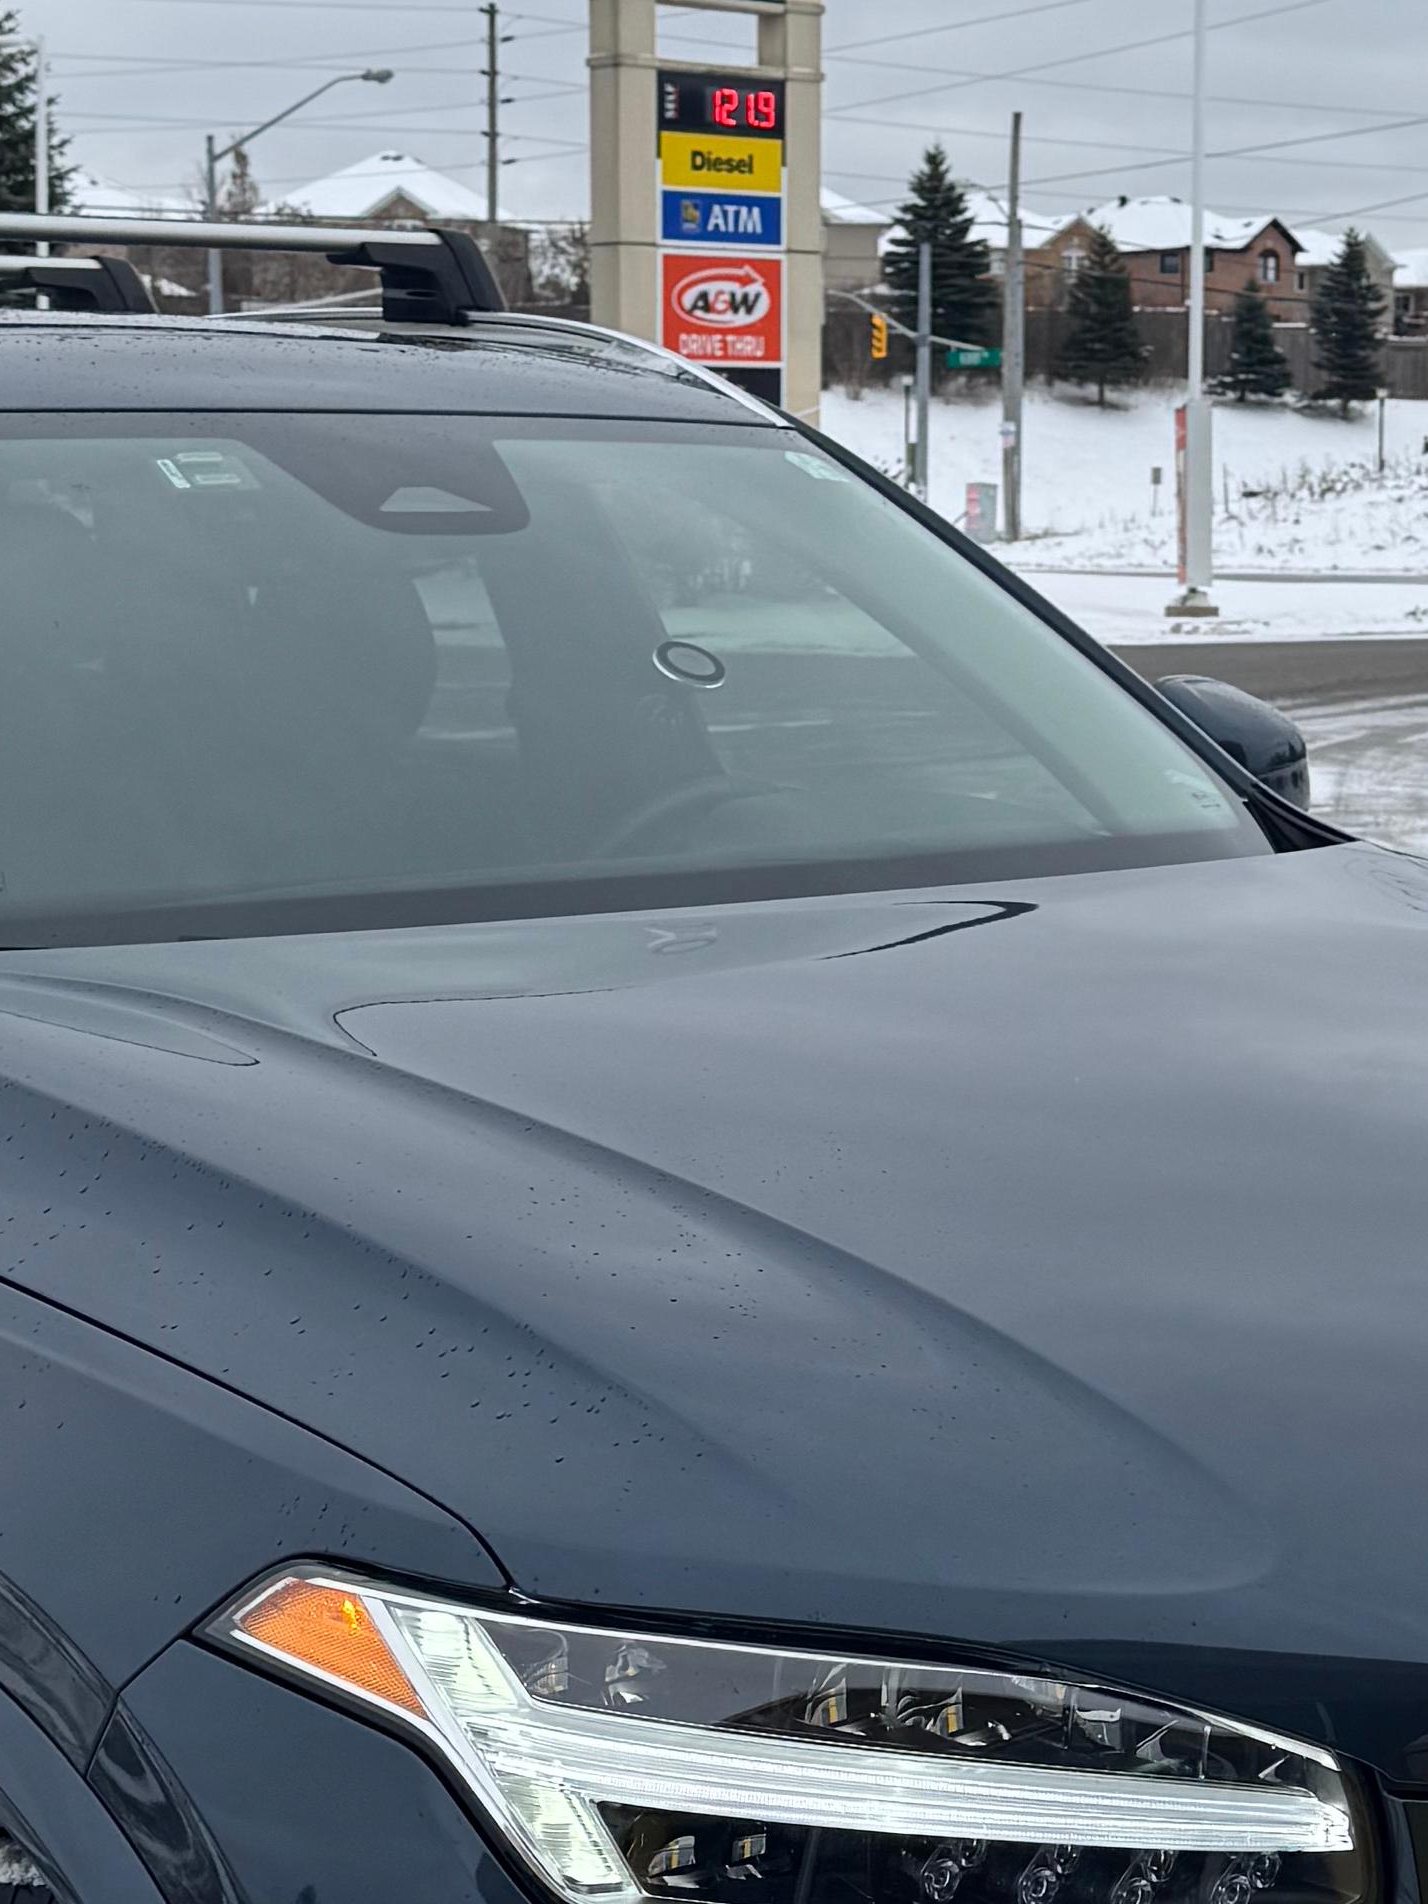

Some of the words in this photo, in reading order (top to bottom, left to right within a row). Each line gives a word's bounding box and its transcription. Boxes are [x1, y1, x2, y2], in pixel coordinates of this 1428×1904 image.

[690, 150, 755, 175] Diesel
[707, 204, 763, 234] ATM
[688, 289, 762, 316] A&W
[678, 333, 725, 356] DRIVE
[726, 335, 765, 358] THRU
